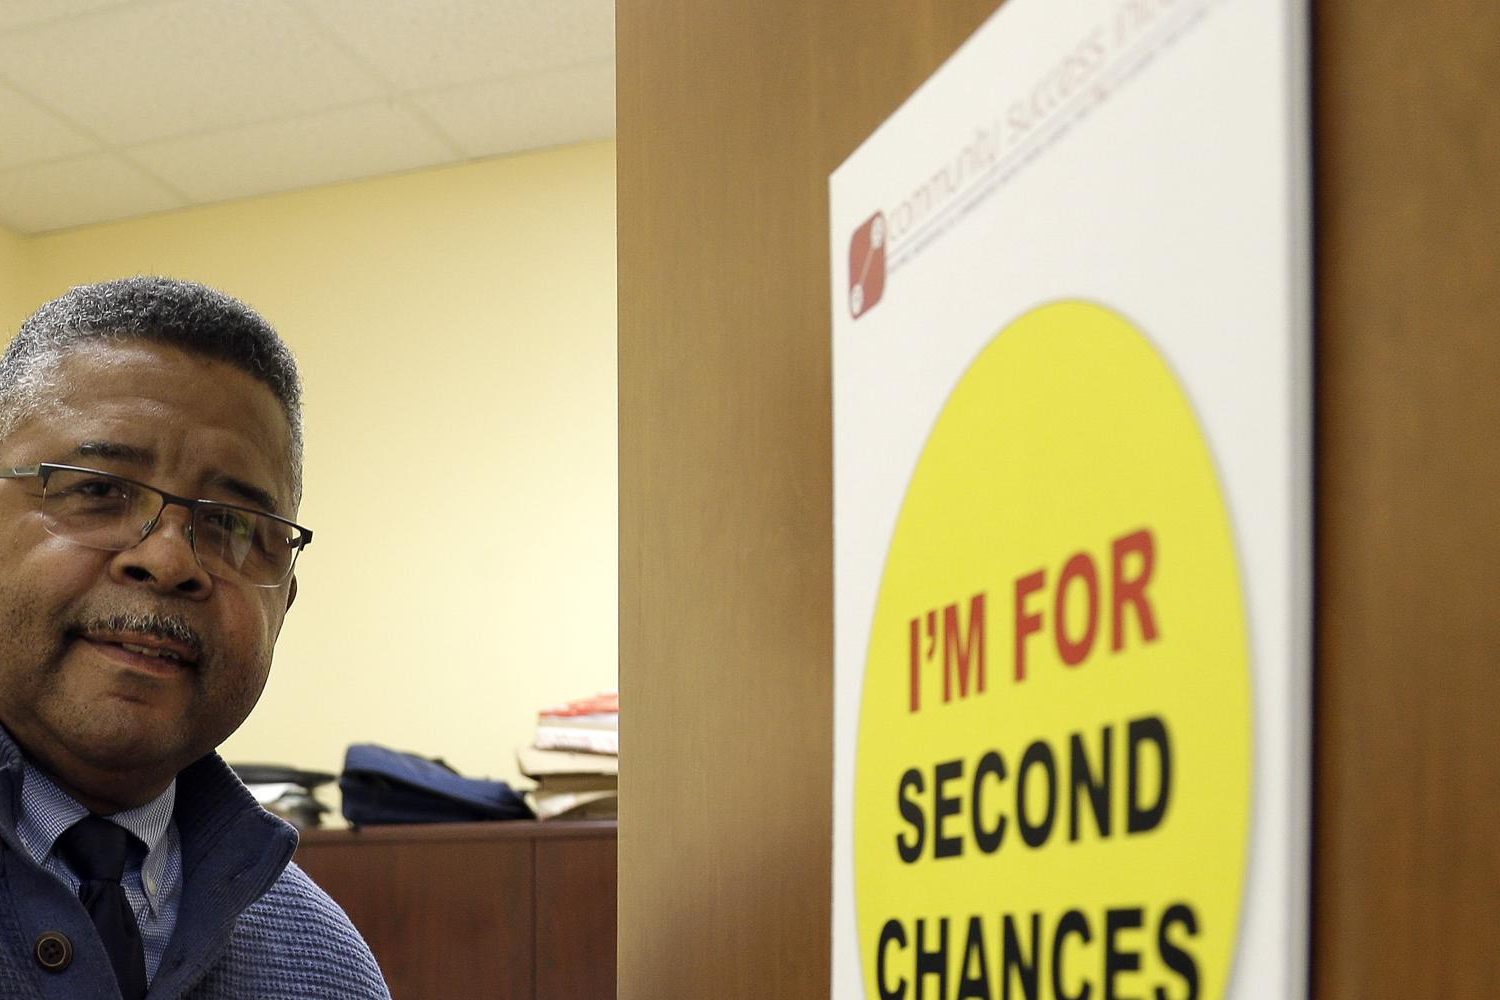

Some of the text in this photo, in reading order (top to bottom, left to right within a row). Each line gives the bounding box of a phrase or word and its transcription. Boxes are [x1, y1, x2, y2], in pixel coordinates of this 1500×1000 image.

[908, 526, 1162, 715] I'M FOR
[895, 713, 1175, 865] SECOND
